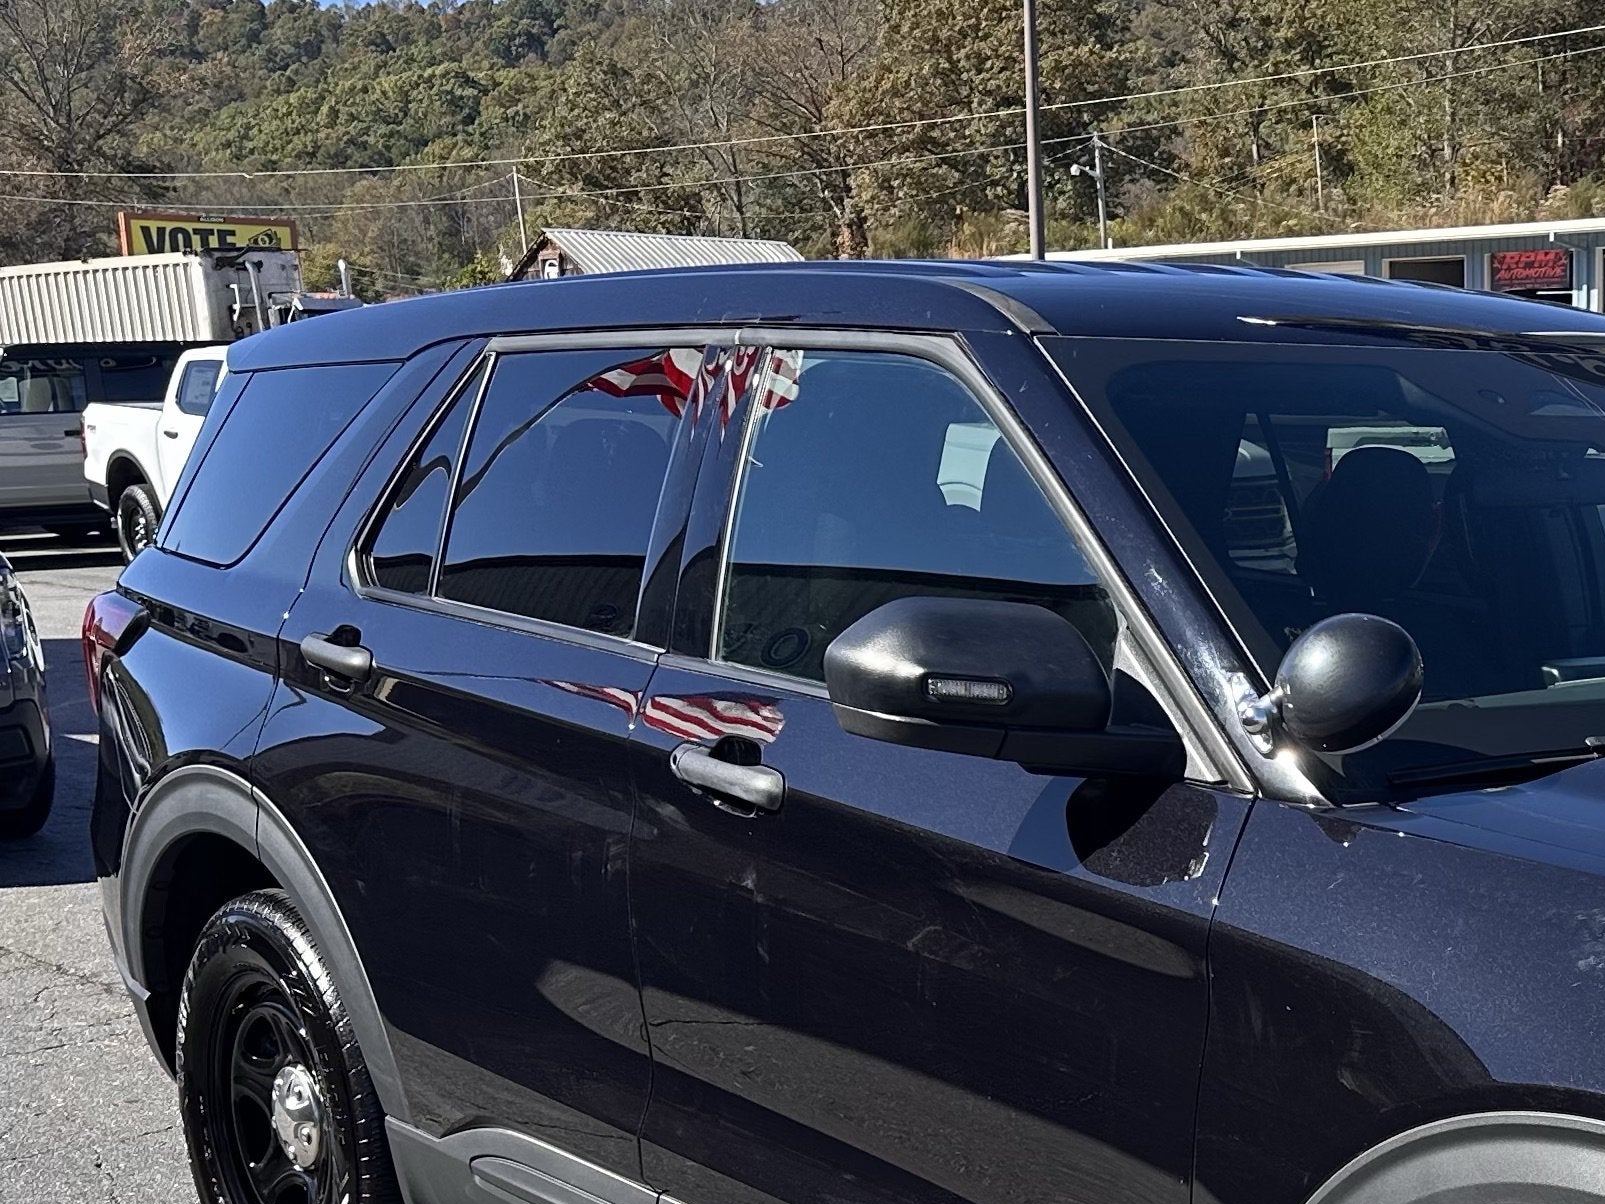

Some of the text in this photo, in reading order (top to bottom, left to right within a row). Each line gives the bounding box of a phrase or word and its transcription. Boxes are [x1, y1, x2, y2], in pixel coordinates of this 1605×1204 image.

[140, 225, 237, 254] VOTE
[1502, 251, 1557, 269] RPM
[1495, 266, 1564, 281] AUTOMOTIVE
